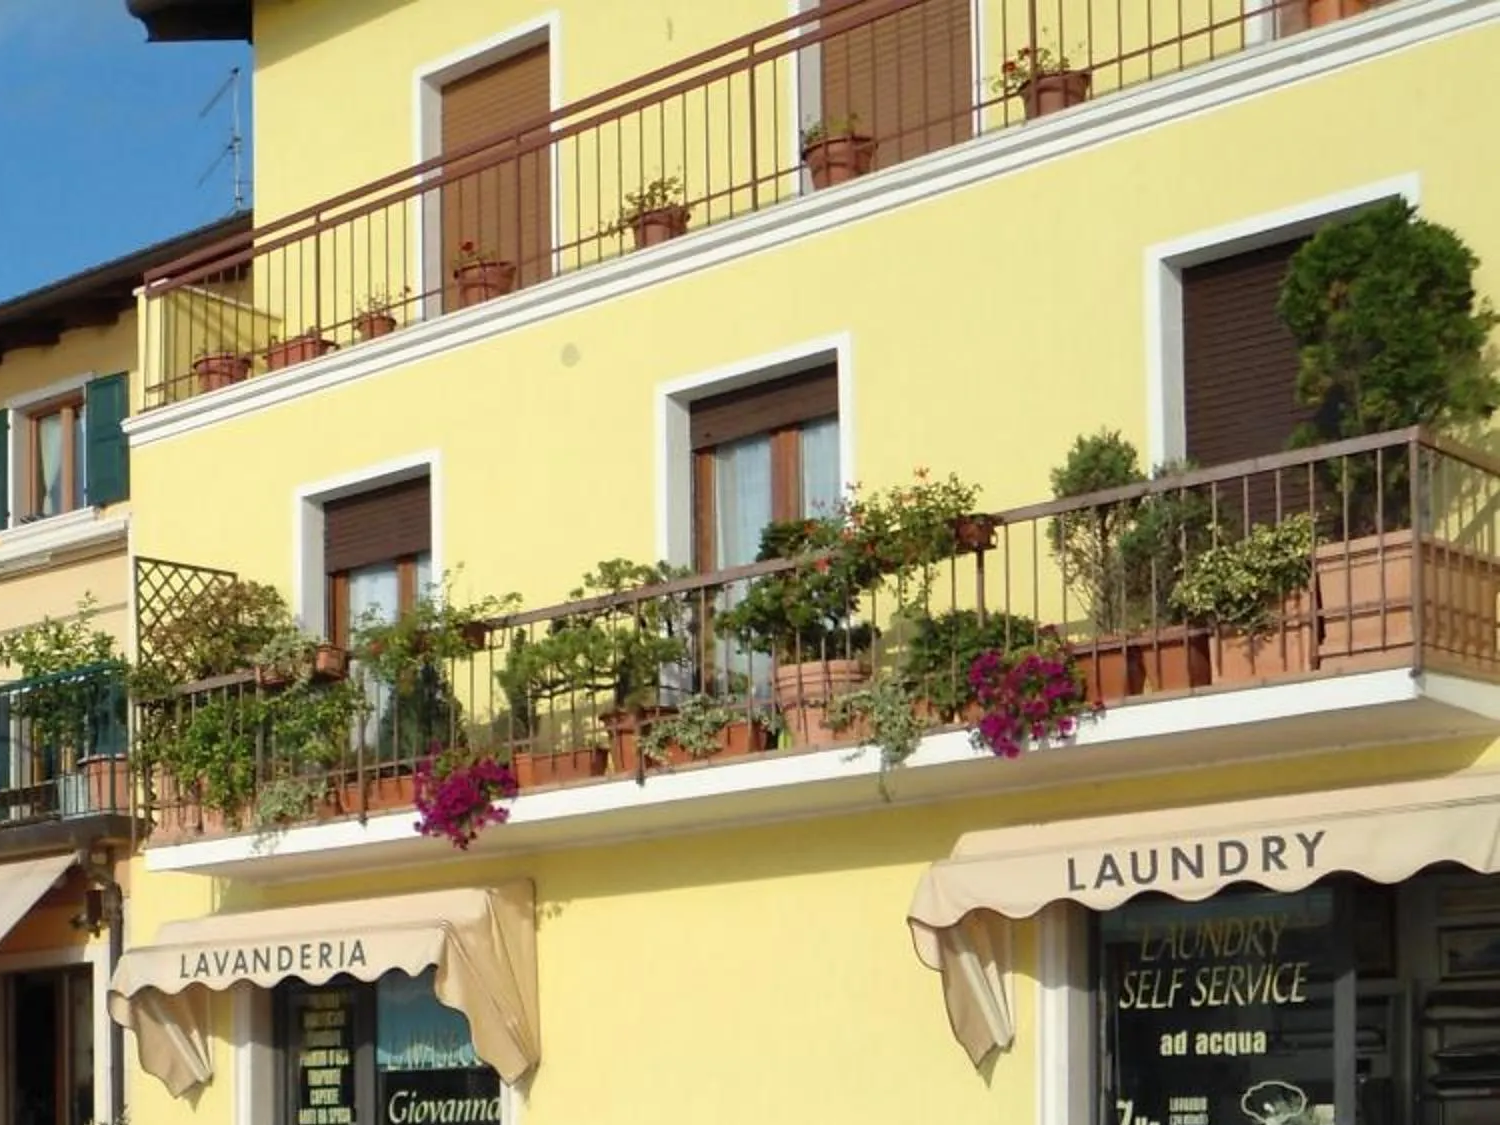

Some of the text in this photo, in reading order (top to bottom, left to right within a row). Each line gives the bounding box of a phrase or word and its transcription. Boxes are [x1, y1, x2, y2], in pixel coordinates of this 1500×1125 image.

[1067, 830, 1325, 892] LAUNDRY
[180, 939, 367, 978] LAVANDERIA
[1141, 914, 1288, 961] LAUNDRY
[1119, 962, 1310, 1009] SELF SERVICE
[1160, 1030, 1267, 1056] ad acqua
[389, 1090, 501, 1124] Giovanna
